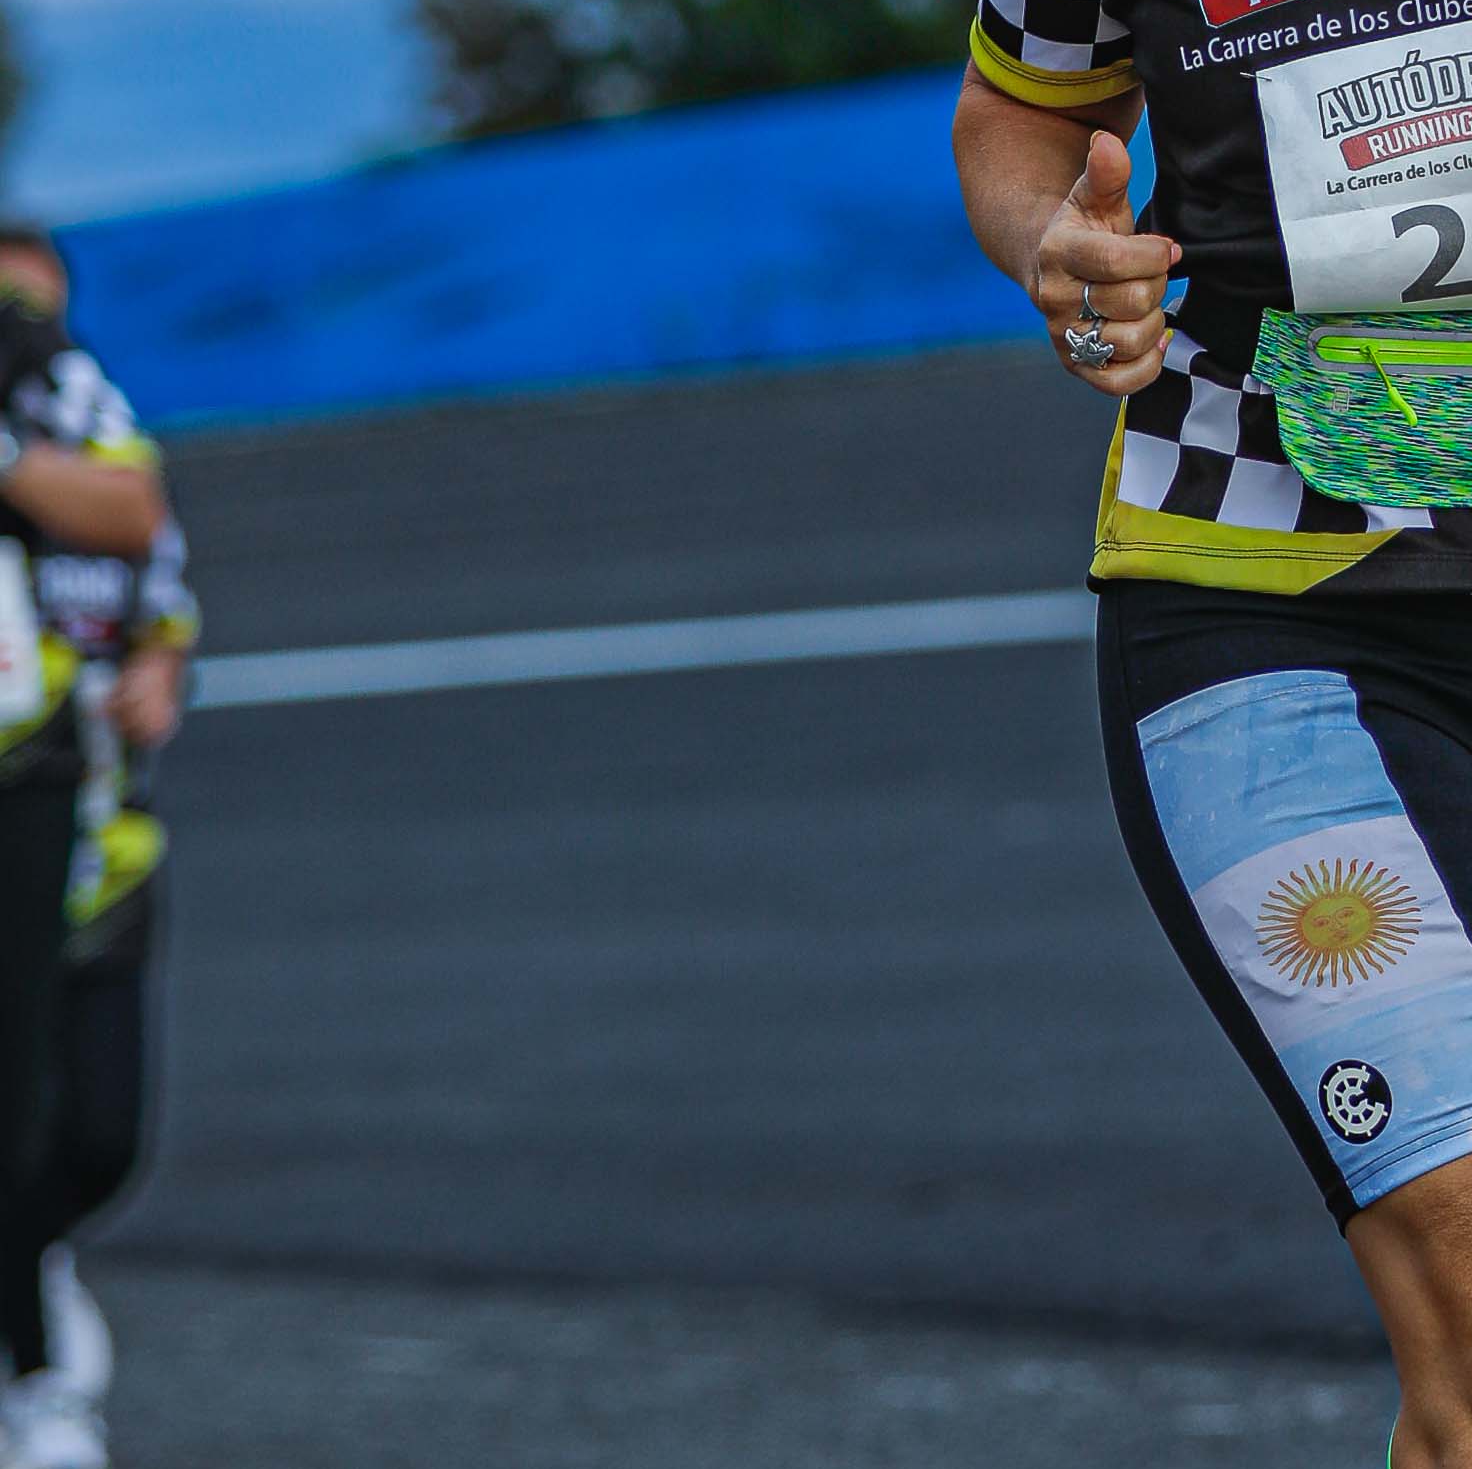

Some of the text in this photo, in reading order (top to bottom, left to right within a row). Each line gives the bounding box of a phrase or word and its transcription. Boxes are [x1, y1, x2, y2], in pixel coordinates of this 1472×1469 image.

[1179, 45, 1204, 71] La
[1207, 26, 1300, 63] Carrera
[1306, 13, 1342, 42] de
[1349, 8, 1390, 35] los
[1326, 179, 1345, 196] La
[1346, 168, 1404, 192] Carrera
[1405, 163, 1427, 180] de
[1428, 158, 1451, 175] los
